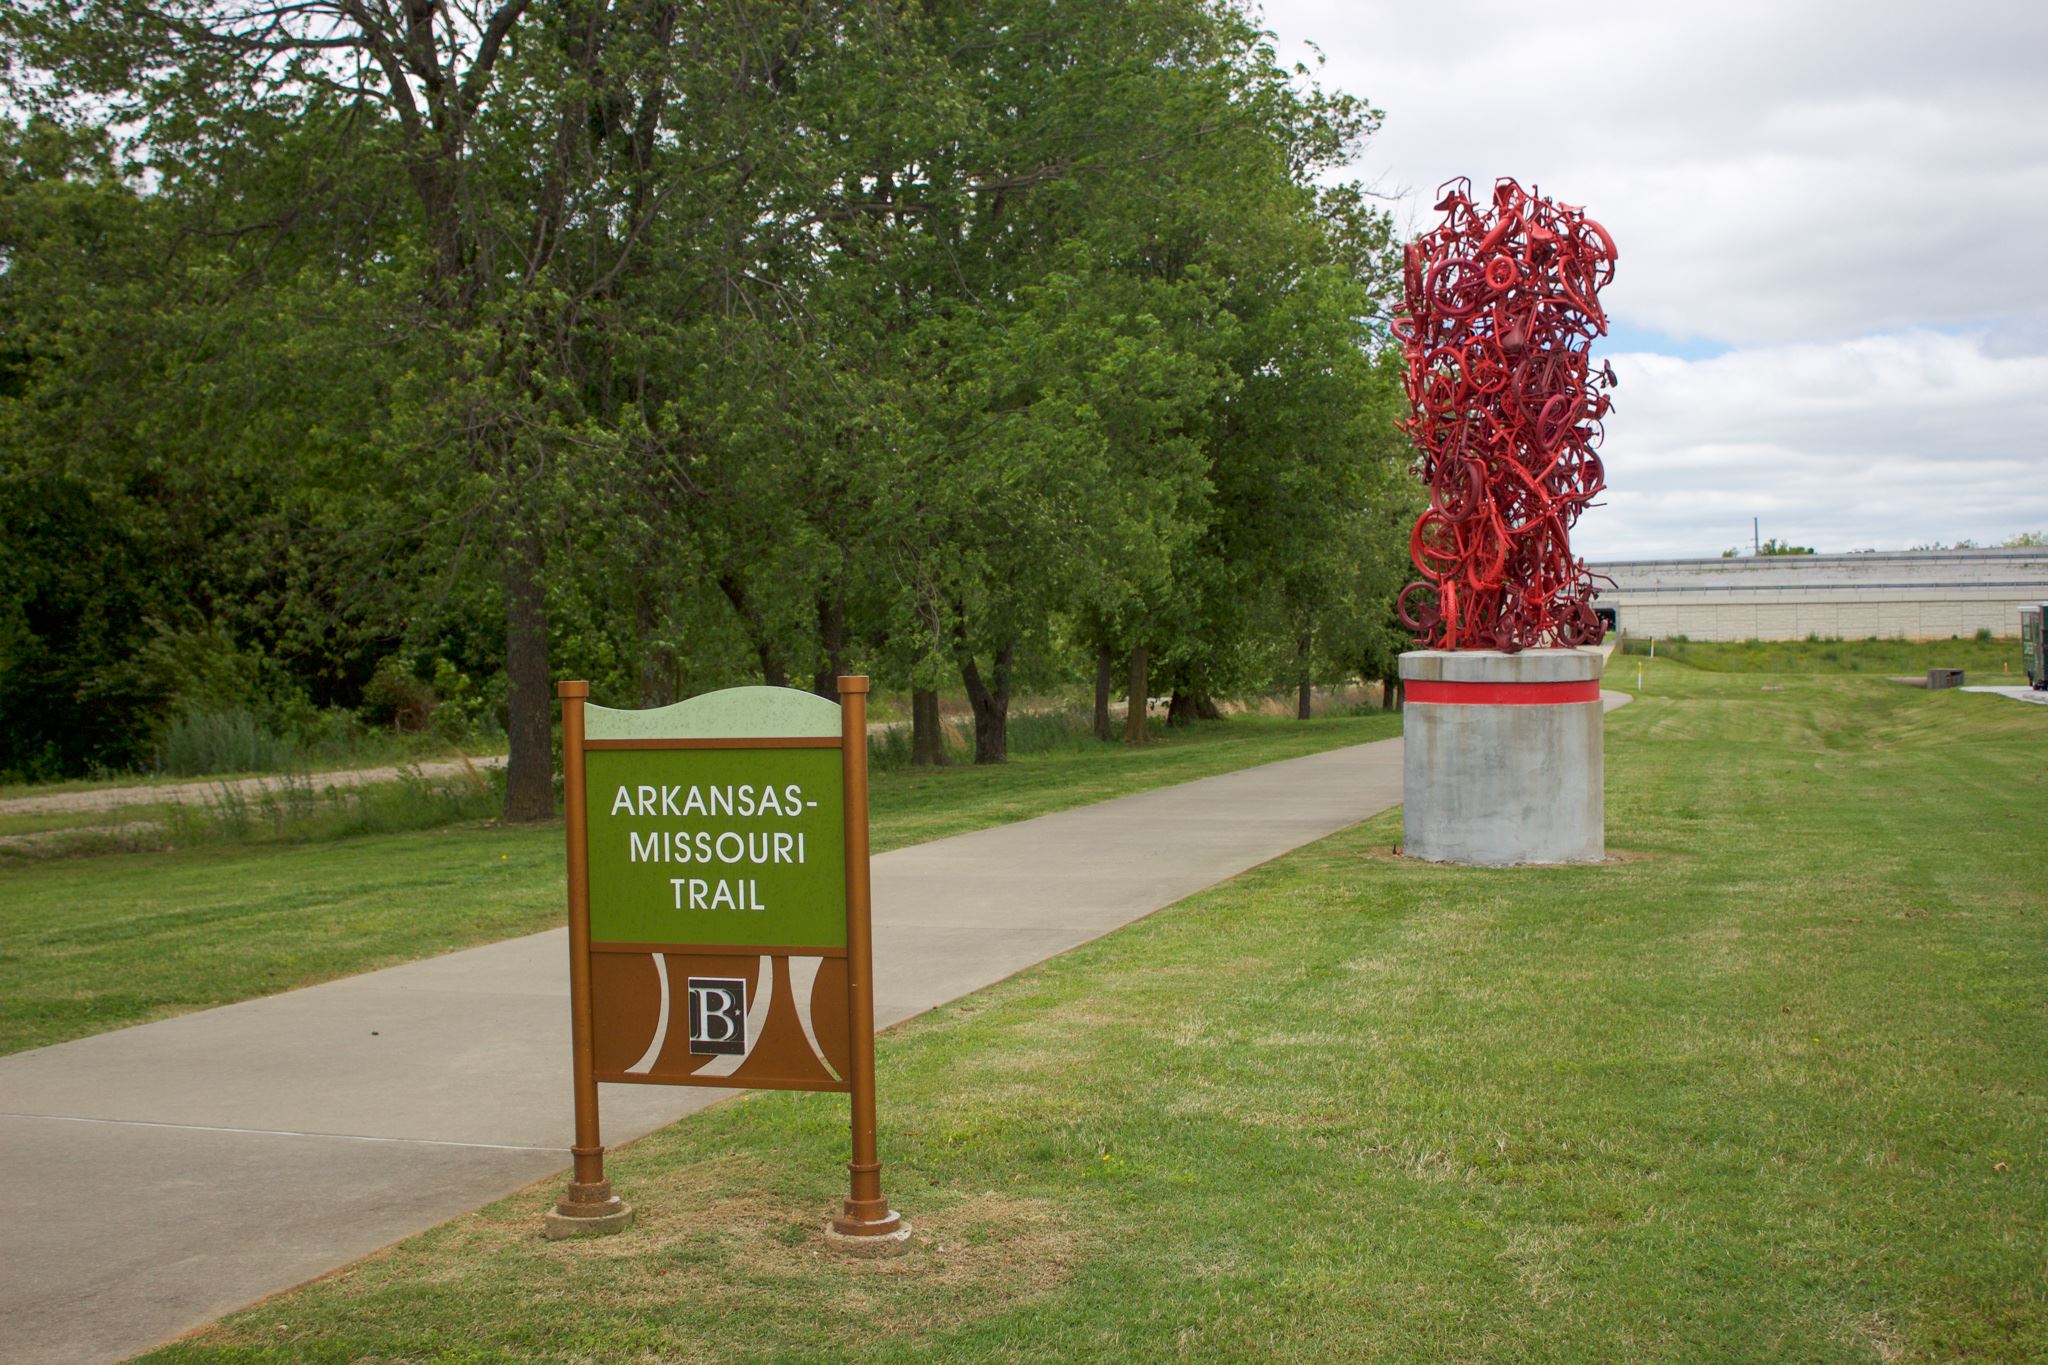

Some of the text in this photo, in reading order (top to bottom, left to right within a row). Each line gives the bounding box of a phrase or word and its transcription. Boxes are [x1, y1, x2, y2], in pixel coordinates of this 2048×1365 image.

[611, 785, 818, 817] ARKANSAS-
[630, 832, 805, 864] MISSOURI
[670, 878, 765, 911] TRAIL
[692, 988, 736, 1041] B
